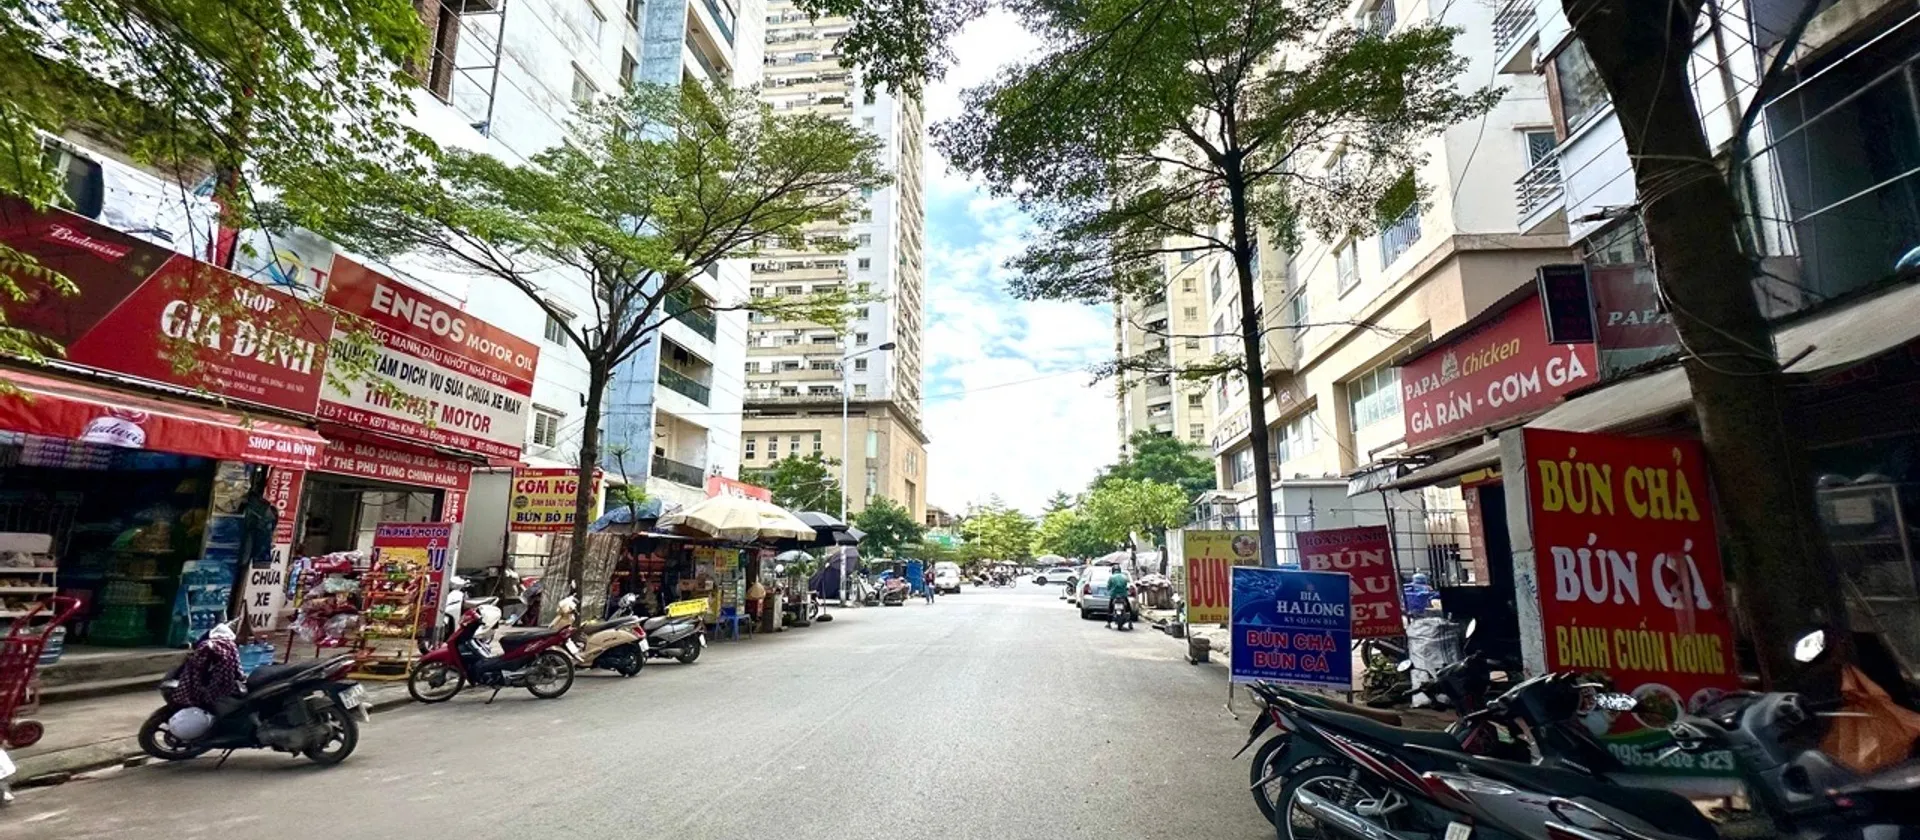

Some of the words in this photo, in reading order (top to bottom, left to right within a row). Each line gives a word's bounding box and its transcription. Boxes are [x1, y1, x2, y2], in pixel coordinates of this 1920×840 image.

[50, 224, 125, 257] Budweiser
[234, 287, 275, 313] SHOP
[371, 283, 466, 343] ENEOS
[466, 336, 513, 367] MOTOR
[515, 353, 533, 371] OIL
[1404, 371, 1441, 401] PAPA
[1462, 337, 1520, 377] Chicken
[491, 391, 503, 409] XE
[1411, 404, 1433, 434] GÀ
[1436, 391, 1473, 426] RÁN
[1487, 366, 1542, 408] CƠM
[1545, 343, 1588, 388] GÀ
[441, 404, 492, 434] MOTOR
[248, 436, 276, 451] SHOP
[276, 440, 292, 454] GIA
[1537, 446, 1615, 516] BÚN
[1623, 447, 1701, 521] CHẢ
[516, 509, 542, 522] BÚN
[417, 527, 449, 537] MOTOR
[1306, 547, 1386, 571] BÚN
[1551, 532, 1640, 606] BÚN
[1651, 538, 1713, 610] CÁ
[254, 592, 271, 607] XE
[1300, 591, 1321, 602] BIA
[1246, 627, 1290, 650] BÚN
[1556, 617, 1611, 669] BÁNH
[1613, 617, 1669, 673] CUỐN
[1253, 647, 1296, 671] BÚN
